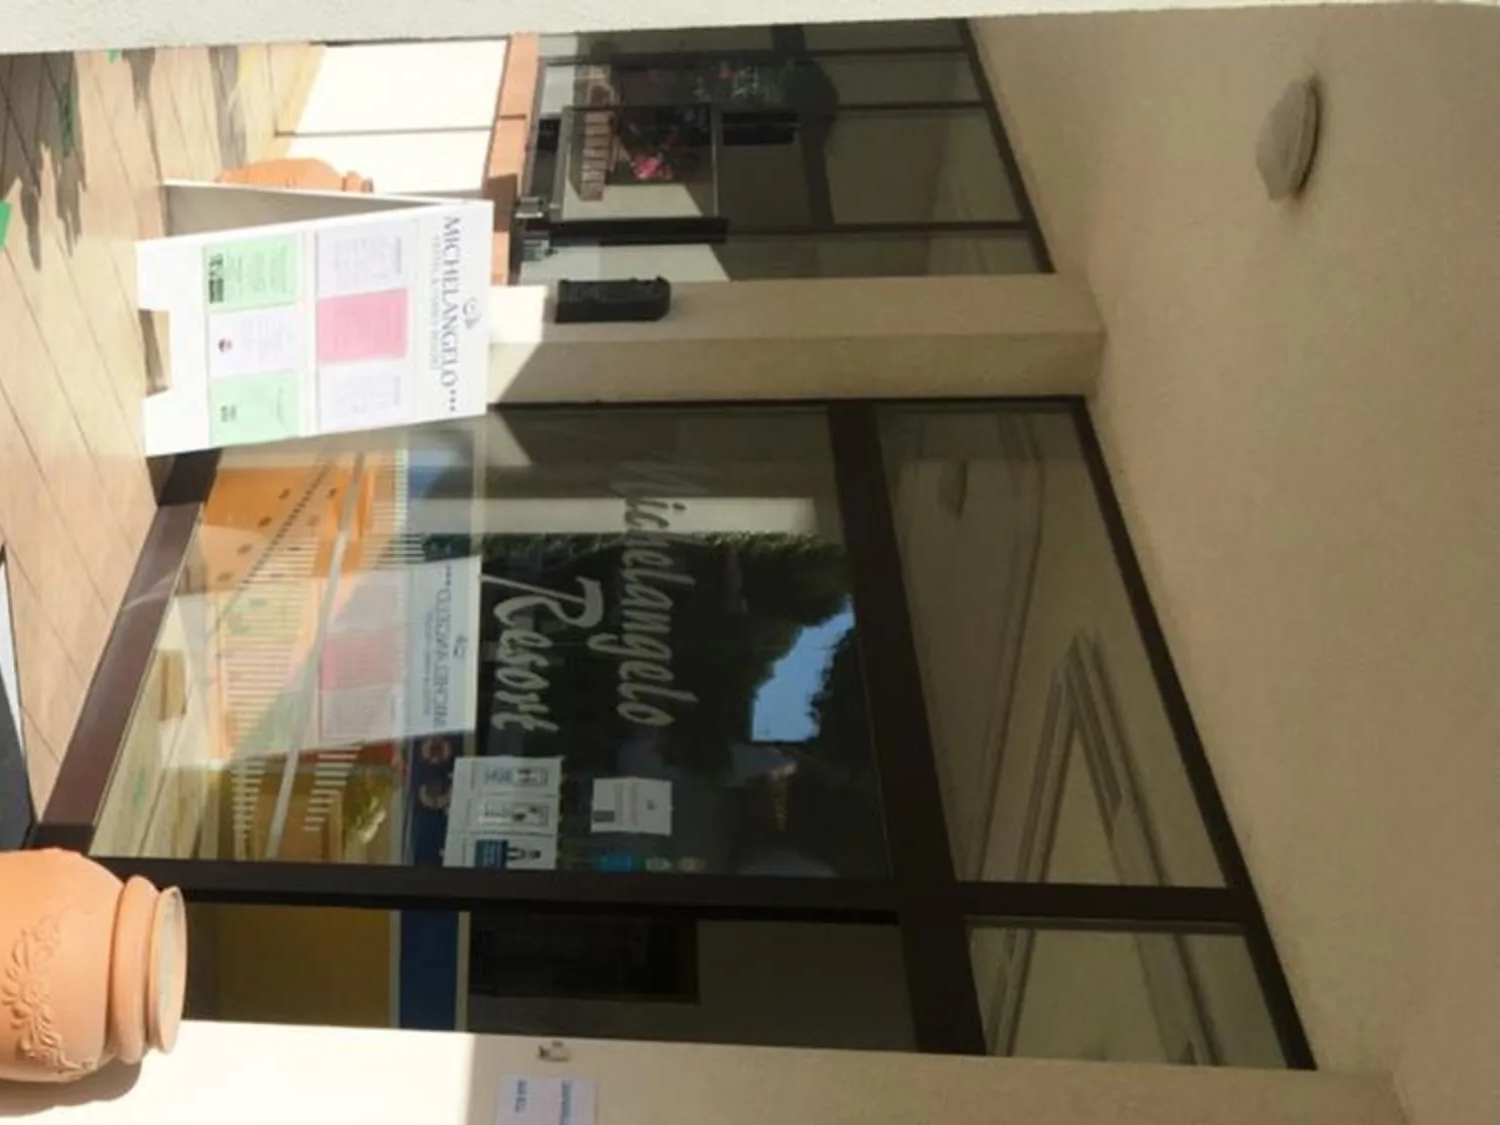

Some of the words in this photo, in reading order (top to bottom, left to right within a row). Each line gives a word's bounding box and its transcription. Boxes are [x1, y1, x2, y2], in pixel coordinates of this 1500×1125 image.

[439, 215, 462, 388] MICHELANGELO
[478, 575, 604, 732] Resort
[588, 459, 701, 726] Michelangelo
